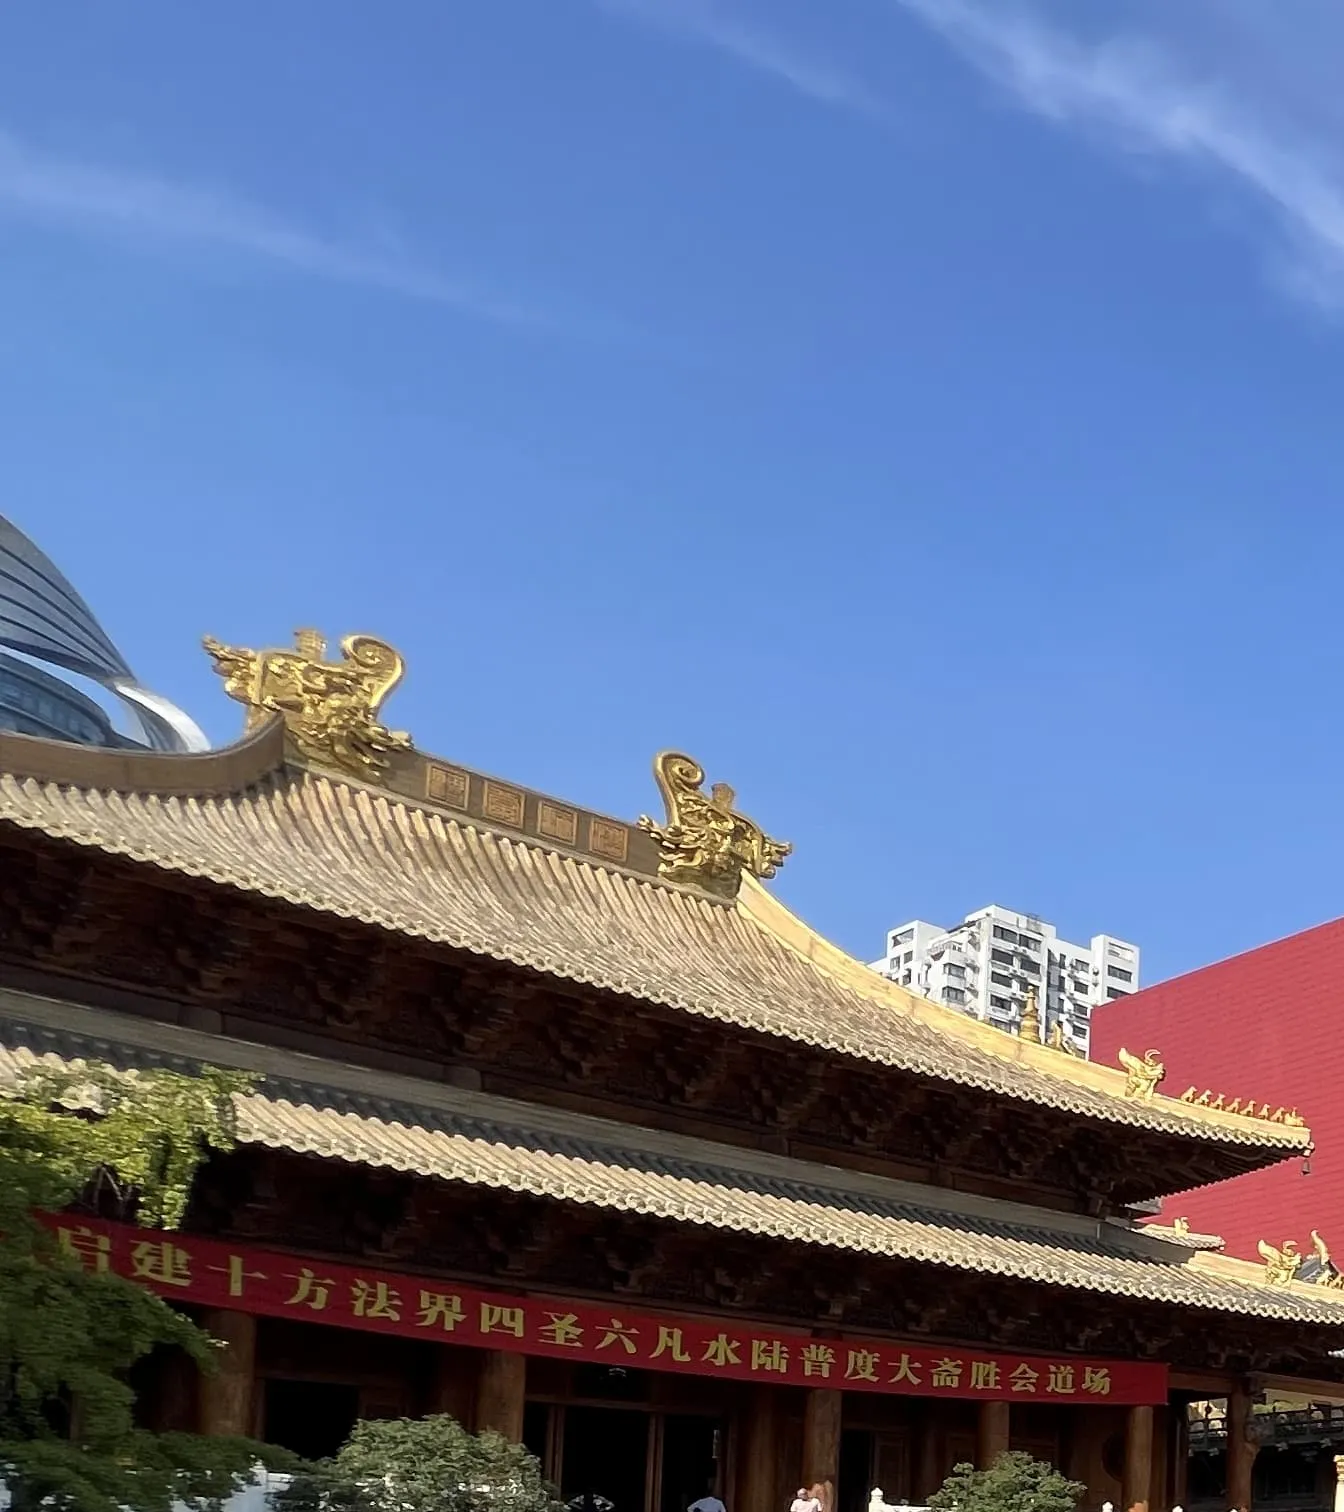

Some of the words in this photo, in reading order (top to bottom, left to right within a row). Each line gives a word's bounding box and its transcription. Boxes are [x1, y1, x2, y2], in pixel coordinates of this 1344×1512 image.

[57, 1226, 1112, 1395] 启建十方法界四圣六凡水陆普度大斋胜会道场
